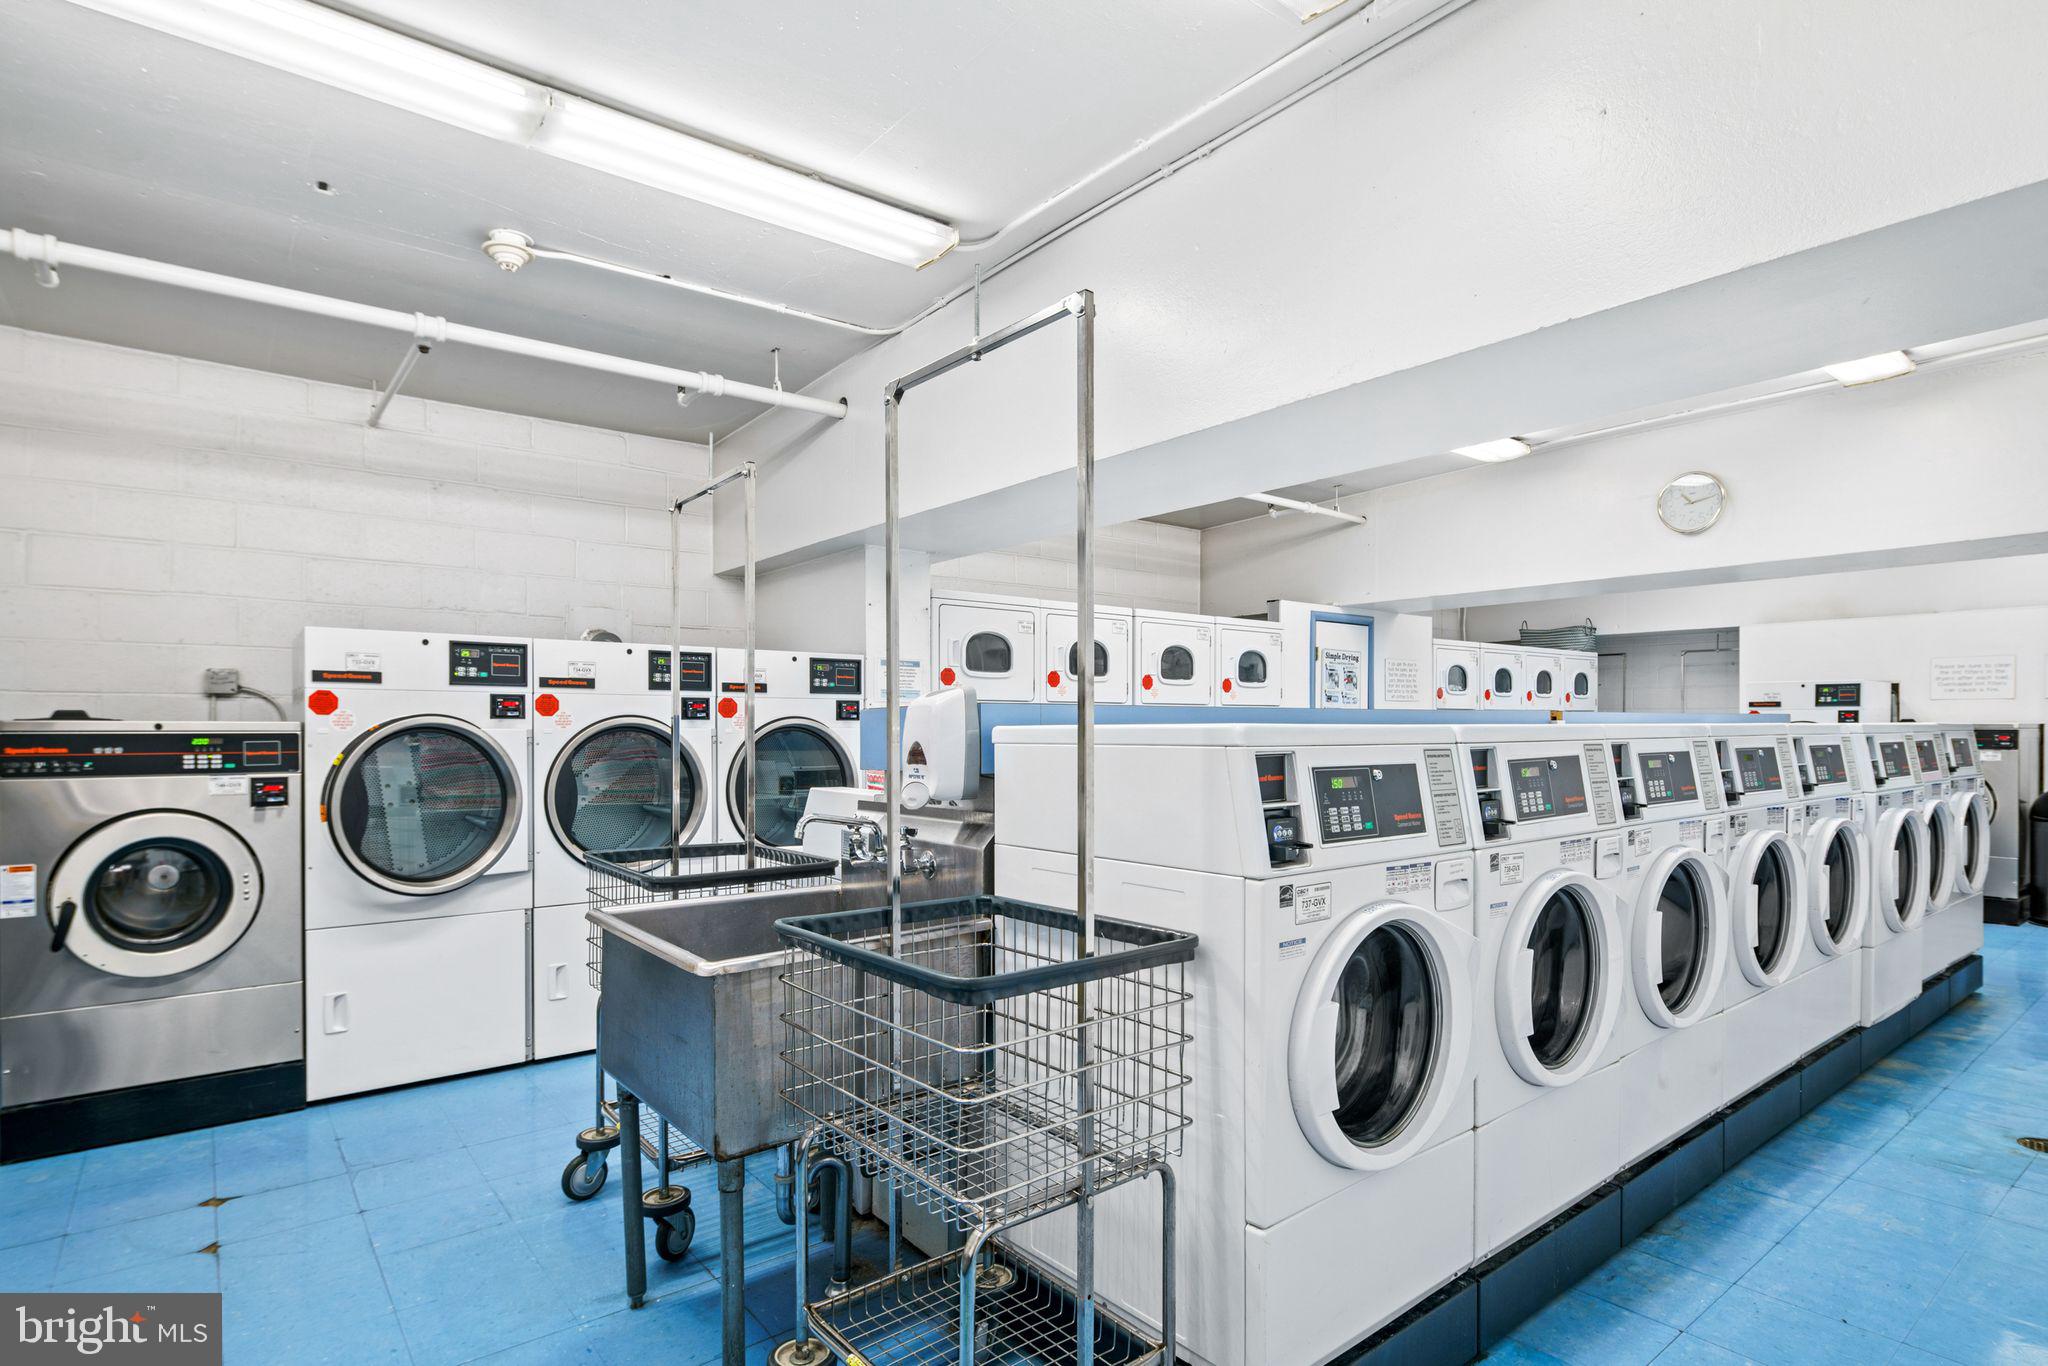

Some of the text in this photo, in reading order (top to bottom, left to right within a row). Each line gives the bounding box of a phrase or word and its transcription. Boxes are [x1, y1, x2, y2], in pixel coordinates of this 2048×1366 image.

[1325, 652, 1341, 661] Simple
[1342, 653, 1359, 663] Drying
[323, 672, 372, 680] Speed Queen
[1302, 897, 1326, 909] 737-GVX
